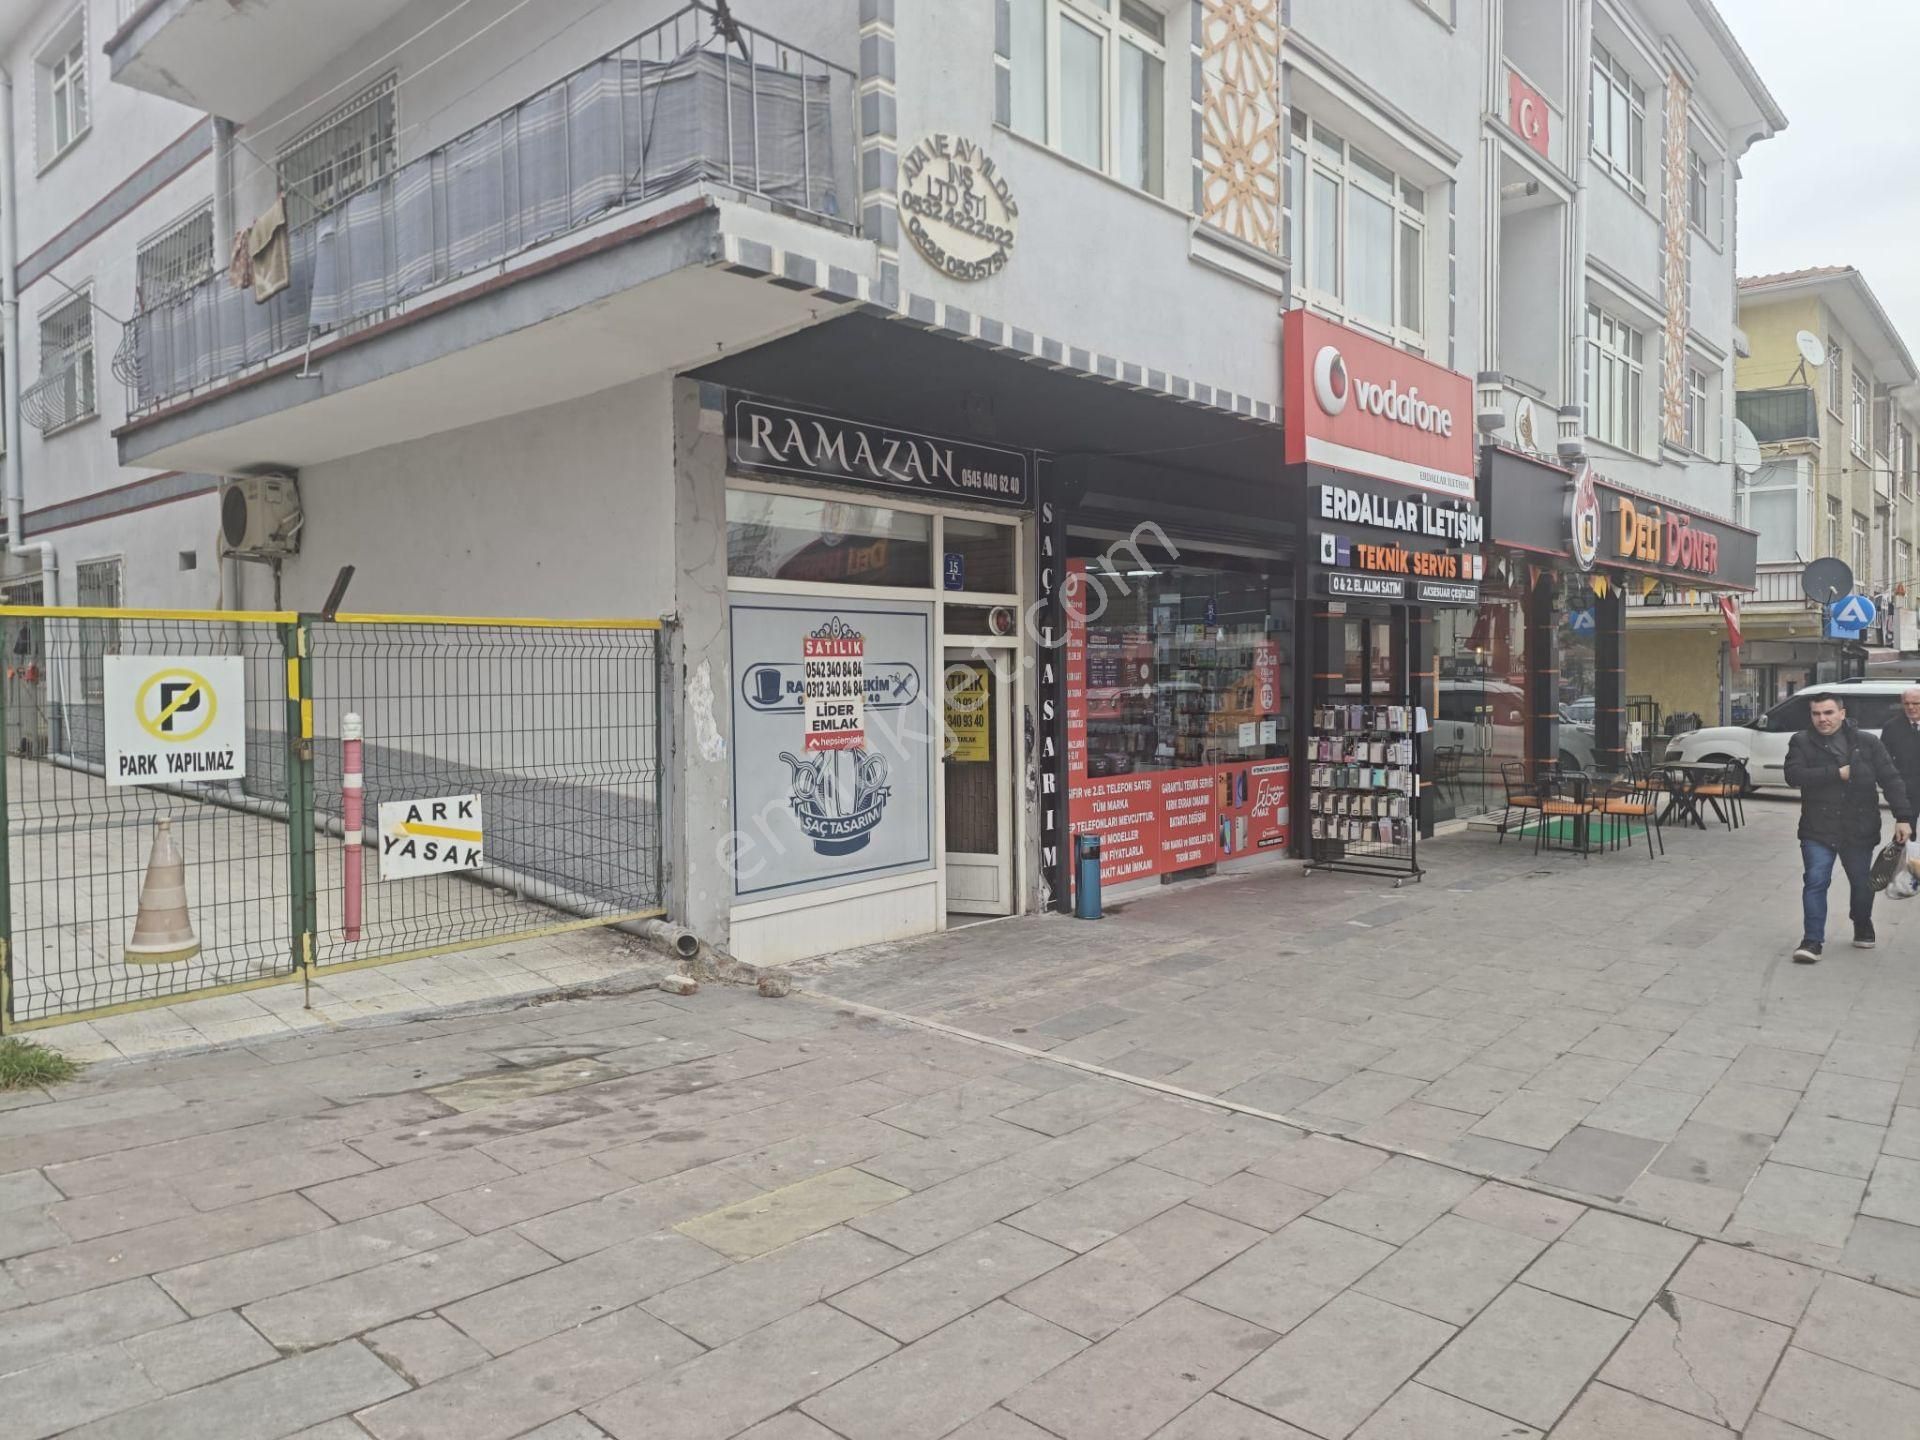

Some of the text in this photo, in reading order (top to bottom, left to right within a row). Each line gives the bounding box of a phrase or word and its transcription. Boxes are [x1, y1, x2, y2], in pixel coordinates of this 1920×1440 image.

[1352, 378, 1452, 437] vodafone
[750, 414, 1020, 494] RAMAZAN 0545 440 62 40
[1321, 484, 1483, 548] ERDALLAR İLETİŞİM
[1619, 496, 1718, 574] DELİ DÖNER
[1041, 502, 1053, 594] SAÇ
[950, 560, 959, 574] 15
[1357, 541, 1409, 573] TEKNİK
[1413, 548, 1457, 578] SERVİS
[1354, 581, 1363, 591] EL
[1364, 581, 1380, 593] ALIM
[1381, 583, 1400, 594] SATIM
[1422, 586, 1451, 597] AKSESUAR
[806, 641, 861, 655] SATILIK
[806, 661, 862, 678] 0542 340 84 84
[806, 680, 862, 698] 0312 340 84 84
[868, 694, 880, 703] 40
[816, 701, 854, 717] LİDER
[813, 718, 858, 731] EMLAK
[963, 714, 973, 728] 93
[974, 714, 985, 728] 40
[1042, 626, 1057, 868] TASARIM
[119, 750, 234, 777] PARK YAPILMAZ
[1107, 782, 1132, 795] TELEFON
[1134, 780, 1152, 792] SATIŞI
[406, 801, 474, 823] ARK
[1093, 798, 1129, 813] TÜM MARKA
[803, 806, 881, 837] SAÇ TASARIM
[1077, 816, 1118, 832] TELEFONLARI
[1107, 830, 1139, 844] MODELLER
[383, 835, 483, 868] YASAK
[1109, 845, 1144, 860] FİYATLARLA
[1116, 862, 1132, 875] ALIM
